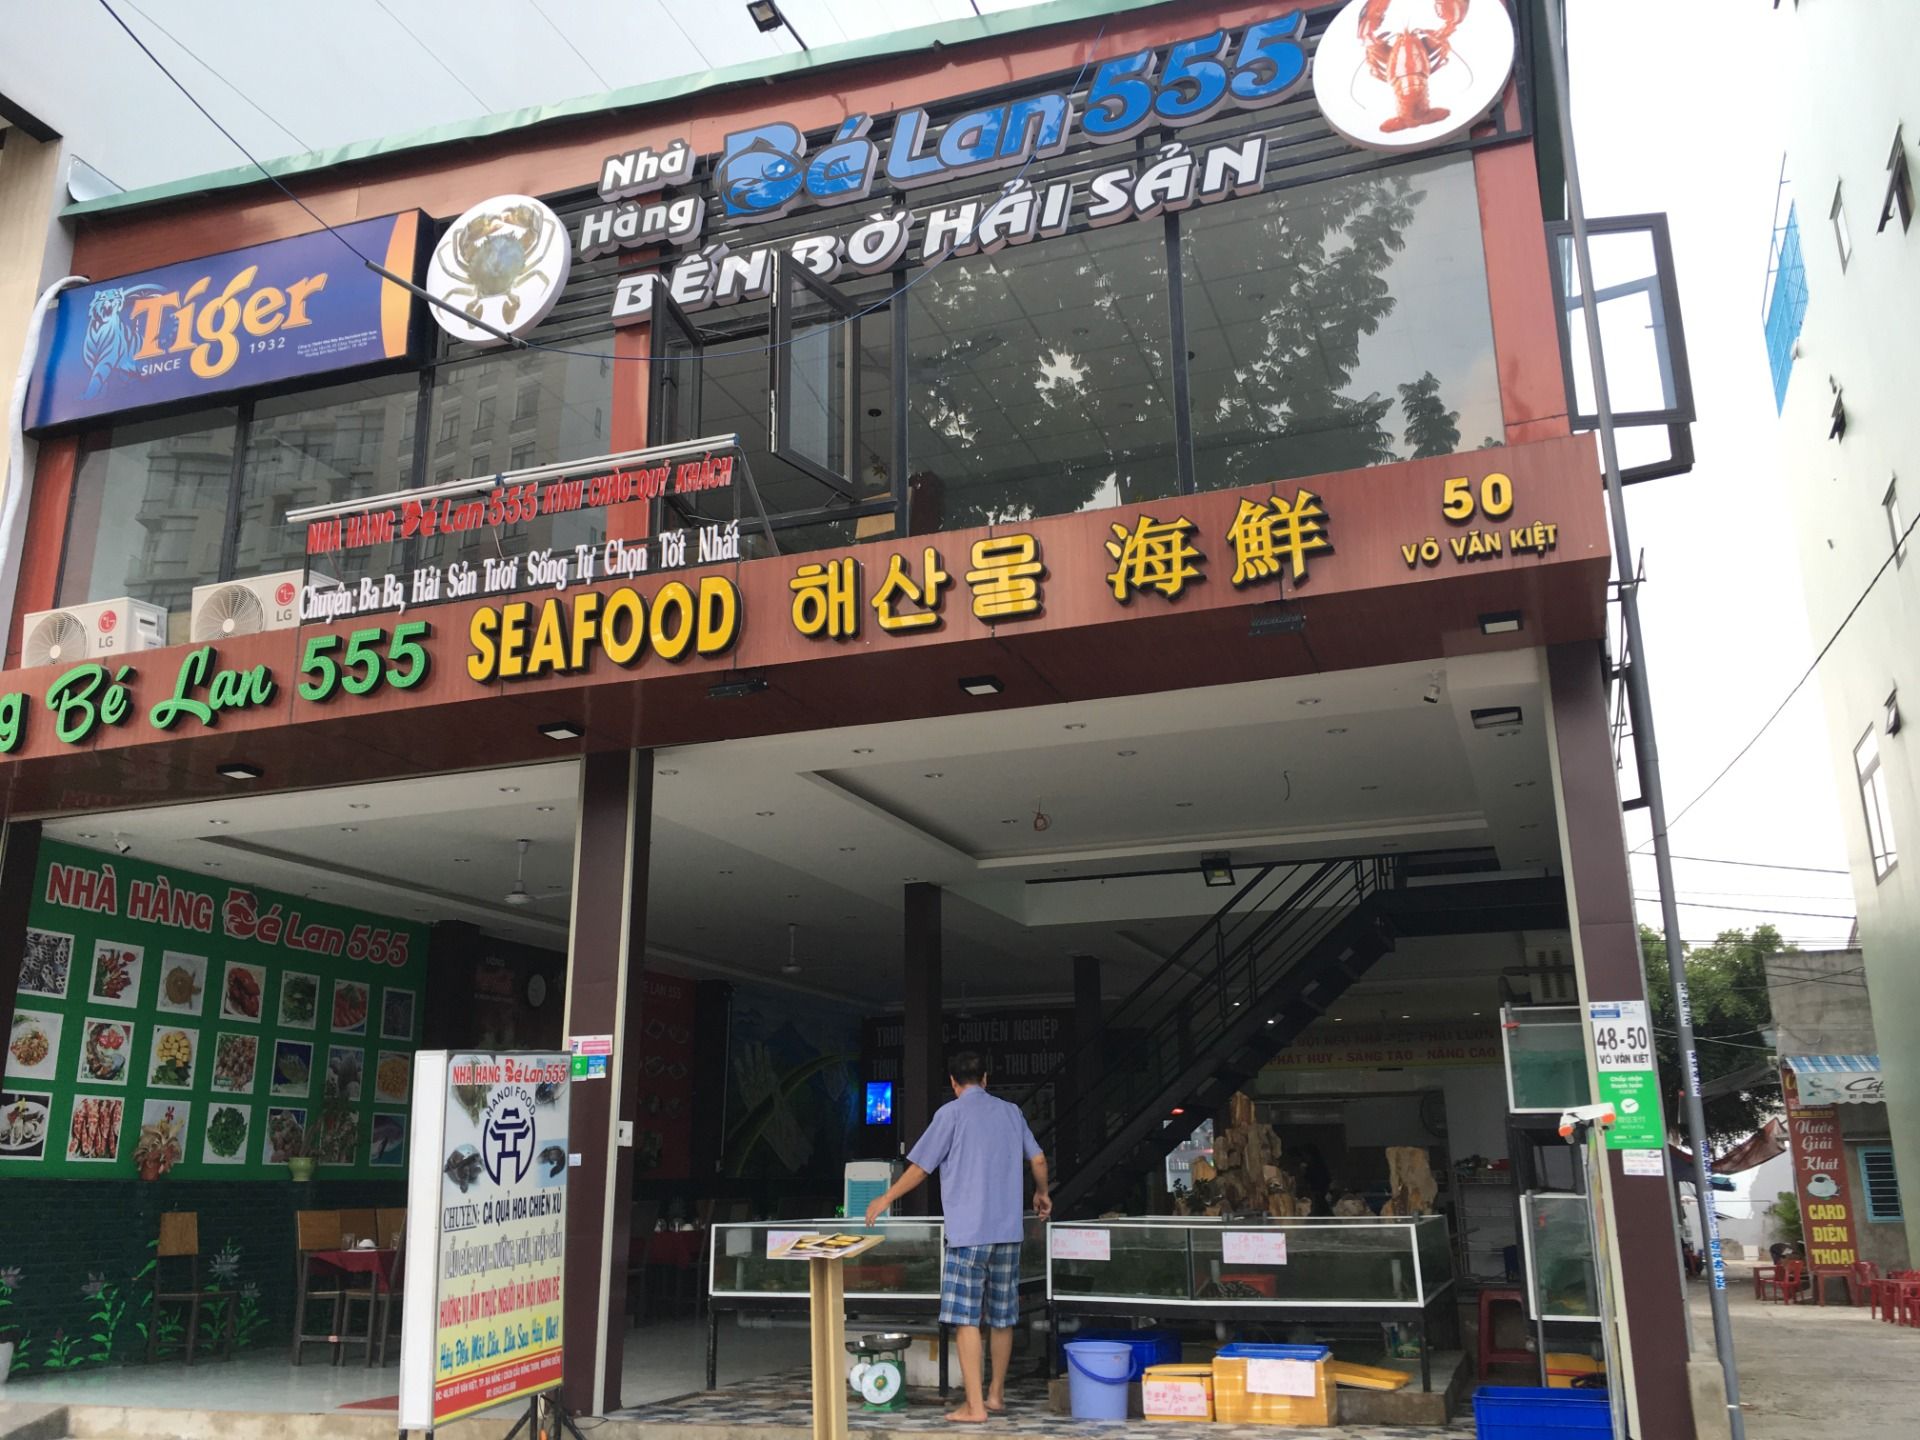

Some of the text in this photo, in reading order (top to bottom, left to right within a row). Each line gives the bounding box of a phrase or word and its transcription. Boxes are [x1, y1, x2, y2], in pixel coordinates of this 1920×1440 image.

[718, 9, 1304, 215] Bé Lan 555
[603, 142, 687, 193] Nhà
[926, 181, 1068, 256] HẢI
[1091, 138, 1264, 217] SẢN
[581, 202, 698, 249] Hàng
[130, 265, 329, 379] Tiger
[140, 358, 181, 377] SINCE
[248, 336, 286, 355] 1932
[307, 514, 341, 555] NHÀ
[346, 509, 395, 549] HÀNG
[440, 499, 485, 534] Lan
[487, 481, 538, 527] 555
[543, 475, 583, 514] KÍNH
[675, 451, 734, 494] KHÁCH
[1442, 473, 1513, 520] 50
[1106, 488, 1330, 600] 海鮮
[1402, 520, 1557, 564] VÕ VĂN KIỆT
[300, 581, 357, 624] Chuyên:
[359, 577, 380, 611] Ba
[412, 565, 441, 604] Hải
[447, 561, 478, 598] Sản
[484, 556, 518, 592] Tươi
[527, 548, 568, 590] Sống
[575, 545, 597, 585] Tự
[604, 538, 647, 579] Chọn
[659, 528, 687, 568] Tốt
[698, 519, 740, 563] Nhất
[789, 533, 1045, 638] 해산물
[276, 610, 292, 623] LG
[468, 577, 736, 682] SEAFOOD
[98, 635, 114, 648] LG
[46, 663, 131, 744] Bé
[149, 646, 271, 730] Lan
[299, 621, 427, 701] 555
[46, 862, 117, 916] NHÀ
[127, 875, 214, 933] HÀNG
[284, 911, 345, 957] Lan
[347, 924, 410, 967] 555
[1597, 1026, 1647, 1050] 48-50
[545, 1063, 568, 1083] 555
[1845, 1077, 1885, 1092] Caf
[486, 1085, 536, 1118] HANOI FOOD
[1801, 1156, 1839, 1171] Khát
[512, 1197, 527, 1220] HOA
[1808, 1204, 1846, 1220] CARD
[1812, 1223, 1849, 1245] ĐIỆN
[1811, 1248, 1855, 1267] THOẠI
